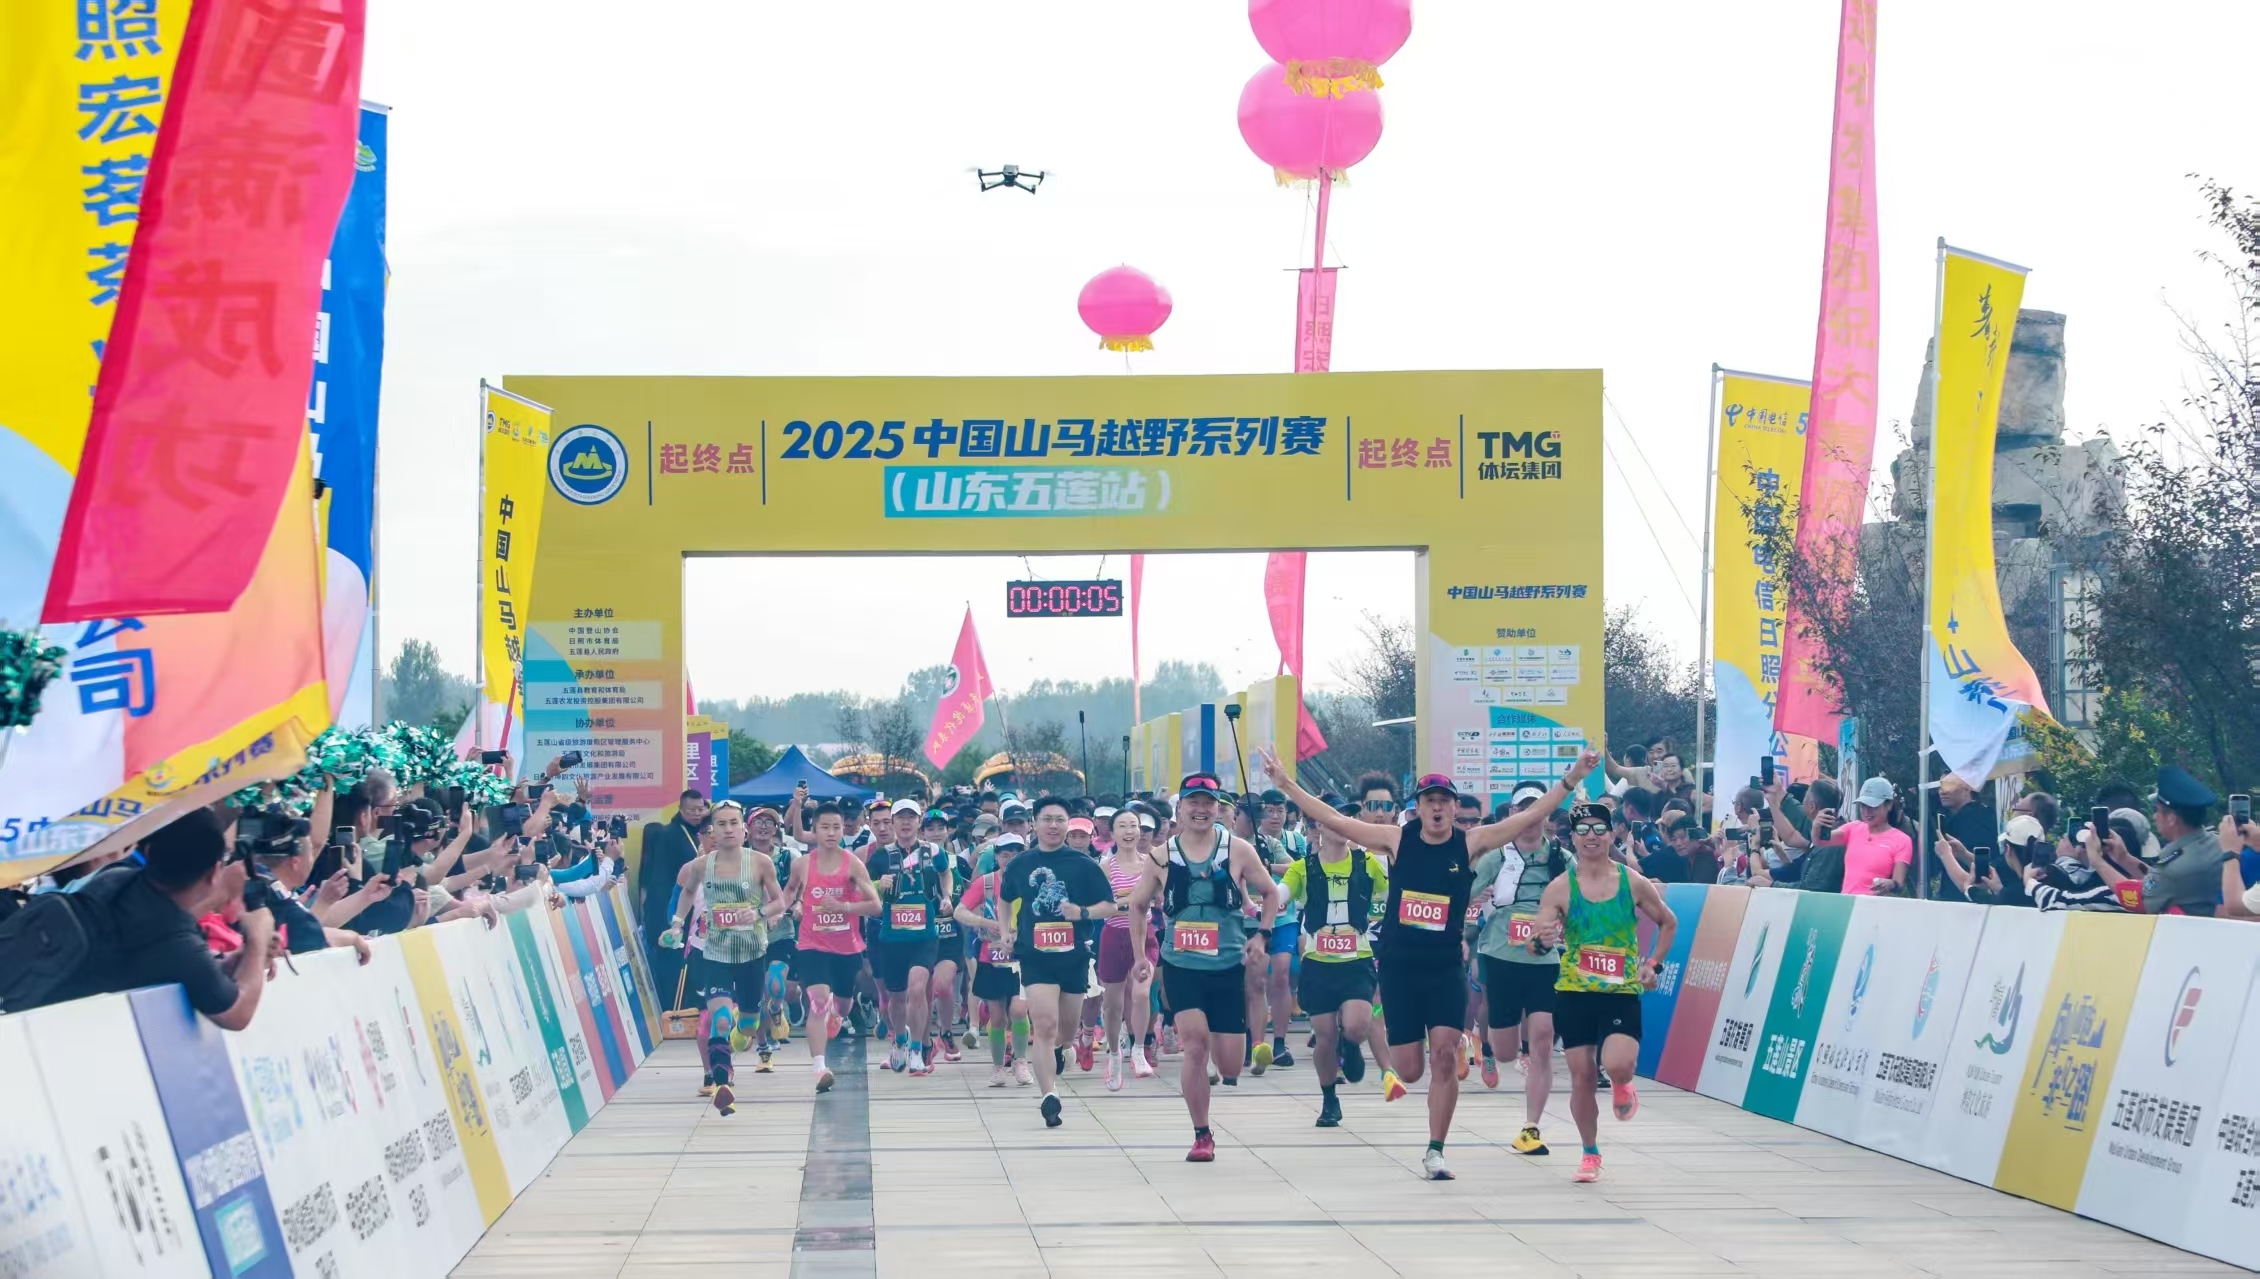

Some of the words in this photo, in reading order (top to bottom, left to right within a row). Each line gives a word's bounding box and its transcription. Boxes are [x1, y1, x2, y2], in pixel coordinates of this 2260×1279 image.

[1477, 430, 1562, 459] TMG
[659, 442, 756, 475] 起终点
[1357, 436, 1454, 471] 起终点
[1477, 461, 1563, 482] 体坛集团
[1009, 585, 1120, 613] 00:00:05
[1446, 584, 1588, 600] 中国山马越野系列赛
[573, 607, 614, 619] 主办单位
[568, 626, 620, 635] 中国登山协会
[1496, 627, 1537, 639] 赞助单位
[568, 636, 620, 646] 日照市体育局
[568, 647, 620, 656] 五莲县人民政府
[574, 669, 615, 680] 承办单位
[562, 686, 626, 694] 五莲县教育和体育局
[575, 717, 616, 729] 协办单位
[718, 911, 739, 925] 101
[817, 912, 844, 924] 1023
[895, 911, 922, 924] 1024
[1406, 902, 1442, 921] 1008
[1041, 931, 1068, 944] 1101
[1180, 930, 1210, 947] 1116
[1322, 937, 1352, 951] 1032
[1588, 955, 1617, 974] 1118
[2111, 1089, 2202, 1147] 五莲城市发展集团
